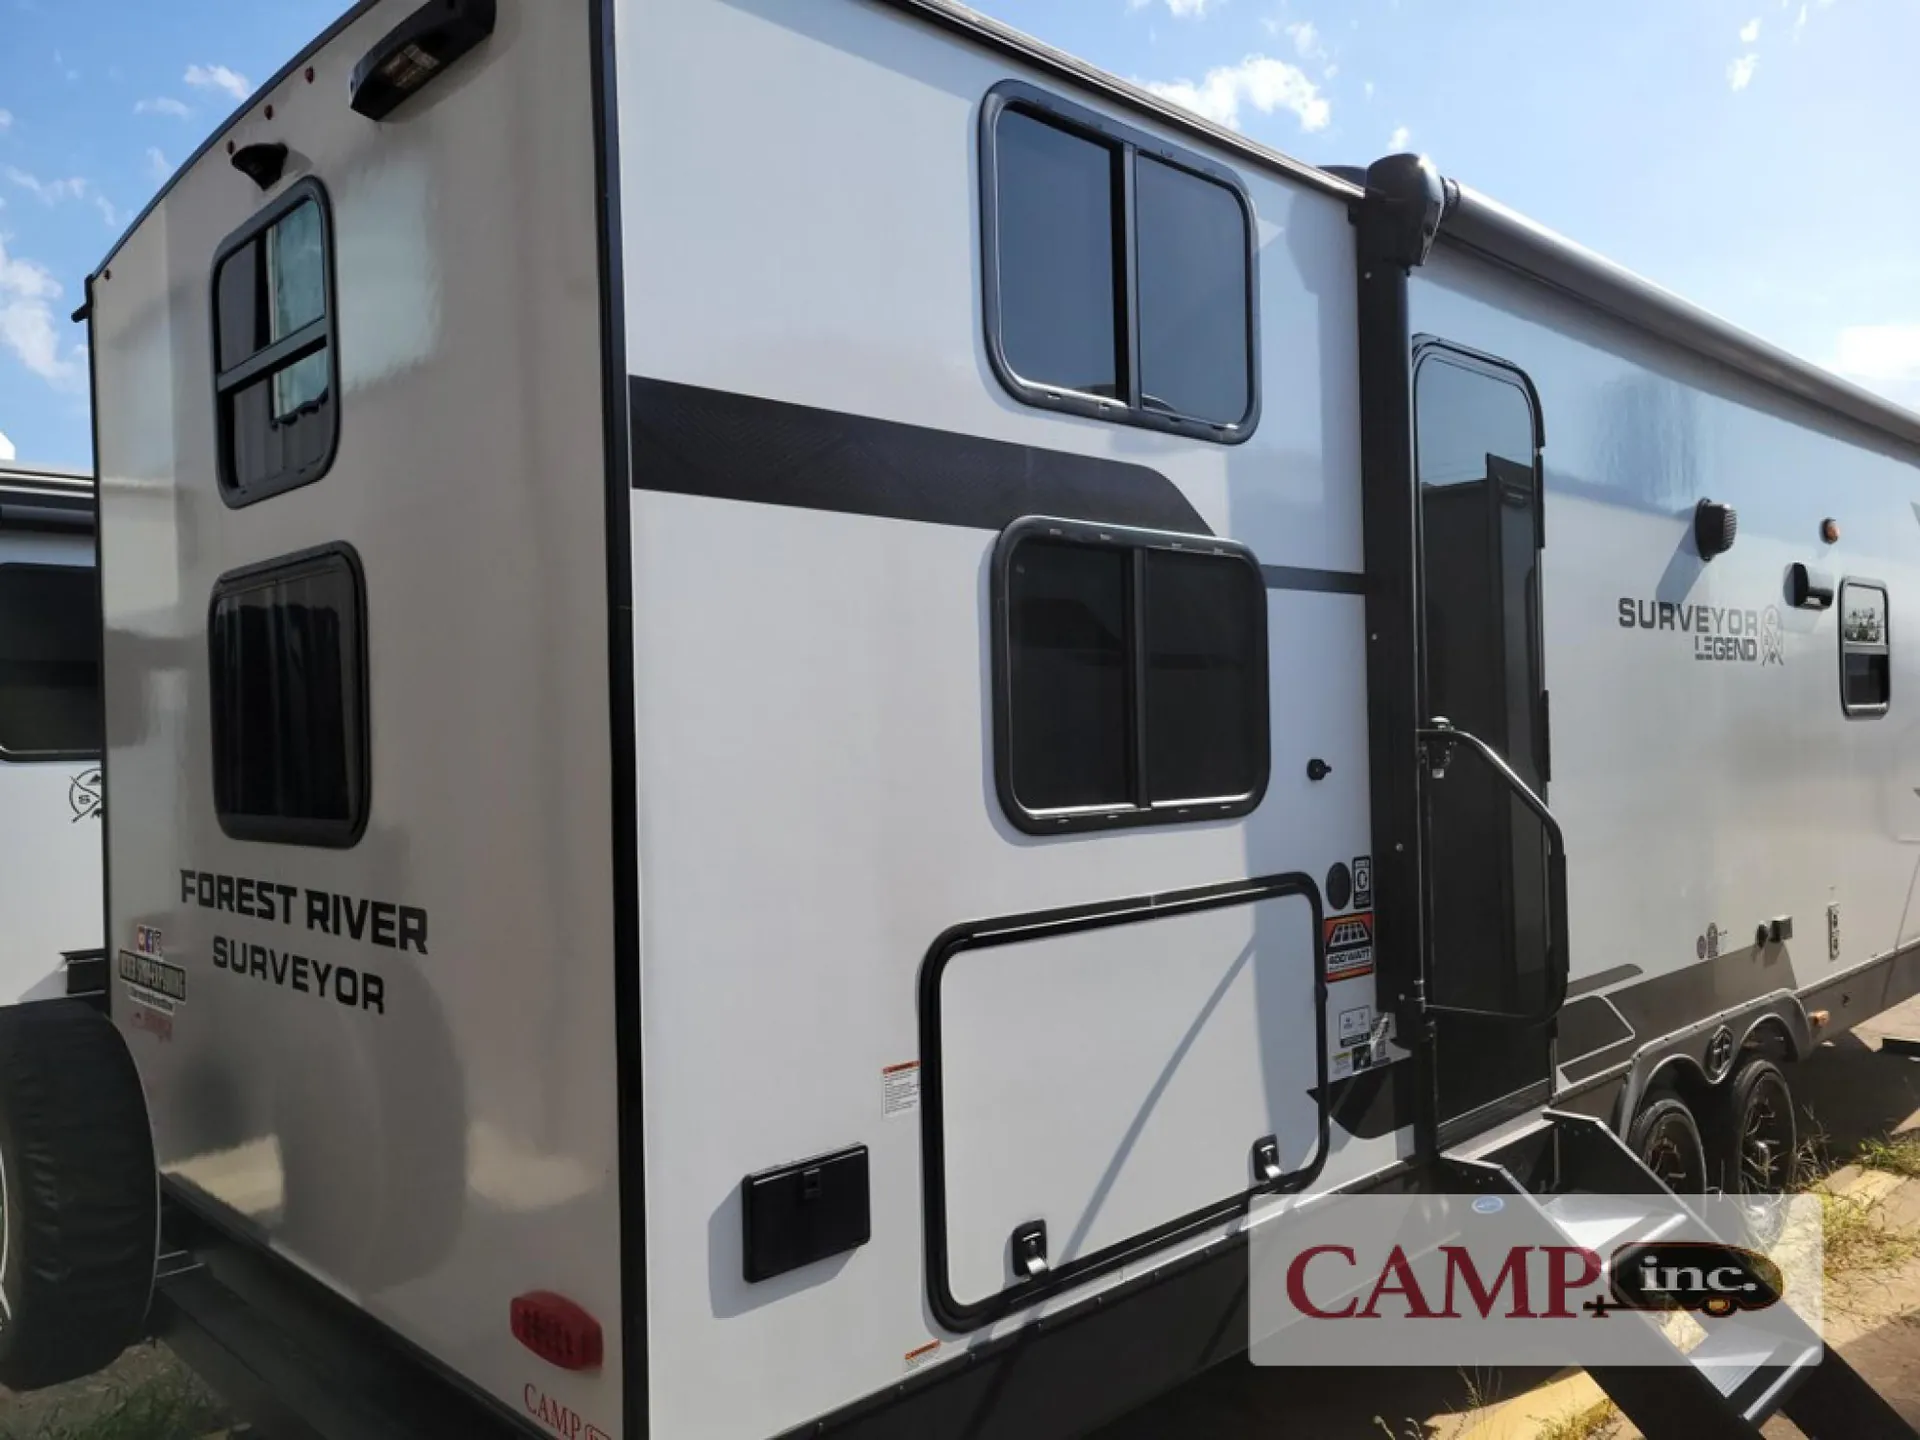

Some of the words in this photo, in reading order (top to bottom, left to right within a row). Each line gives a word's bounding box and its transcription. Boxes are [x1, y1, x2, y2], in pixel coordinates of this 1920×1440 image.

[1619, 598, 1758, 636] SURVEYOR
[1694, 635, 1758, 661] LEGEND
[180, 869, 298, 924] FOREST
[304, 888, 428, 955] RIVER
[213, 934, 385, 1014] SURVEYOR
[524, 1383, 581, 1440] CAMP
